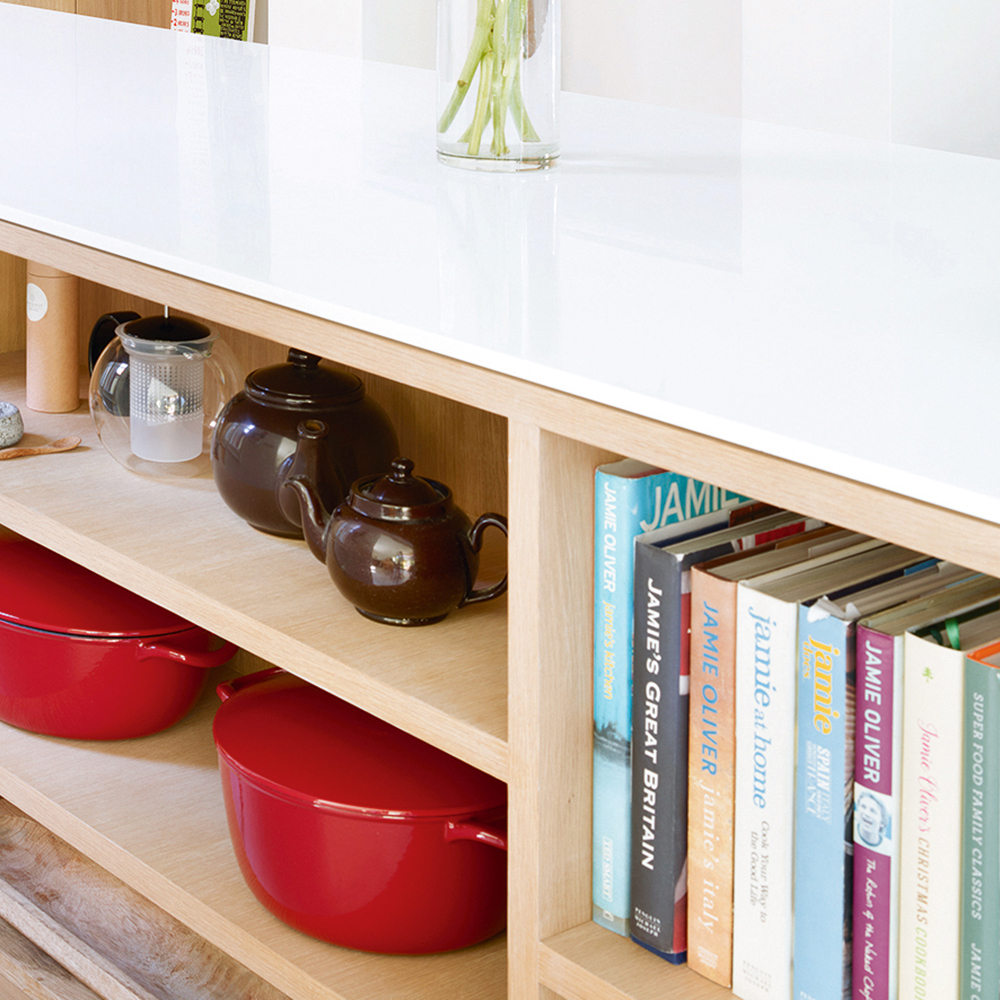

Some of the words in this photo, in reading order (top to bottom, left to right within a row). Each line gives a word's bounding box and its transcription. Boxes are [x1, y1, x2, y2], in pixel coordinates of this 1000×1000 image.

[603, 482, 618, 533] JAMIE
[603, 536, 617, 593] OLIVER
[602, 600, 617, 648] jamie's
[645, 577, 663, 675] JAMIE'S
[703, 601, 719, 676] JAMIE
[603, 650, 617, 700] kitchen
[748, 607, 778, 708] jamie
[865, 640, 882, 706] JAMIE
[808, 635, 840, 735] jamie
[644, 681, 662, 763] GREAT
[701, 684, 718, 776] OLIVER
[753, 709, 773, 726] at
[972, 692, 984, 741] SUPER
[752, 728, 775, 809] home
[816, 745, 831, 791] SPAIN
[863, 709, 881, 784] OLIVER
[917, 718, 939, 771] Jamie
[972, 743, 984, 787] FOOD
[641, 768, 660, 870] BRITAIN
[699, 779, 721, 870] jamie's
[751, 831, 759, 850] the
[761, 820, 770, 850] Cook
[972, 789, 983, 847] FAMILY
[750, 851, 759, 883] Good
[760, 854, 769, 882] Your
[866, 858, 876, 874] The
[916, 837, 930, 925] CHRISTMAS
[971, 848, 983, 920] CLASSICS
[698, 878, 720, 934] italy
[750, 884, 759, 906] Life
[760, 884, 769, 910] Way
[760, 911, 767, 923] to
[865, 923, 875, 938] the
[863, 940, 878, 975] Naked
[914, 926, 928, 1000] COOKBOO
[970, 942, 982, 993] JAMIE
